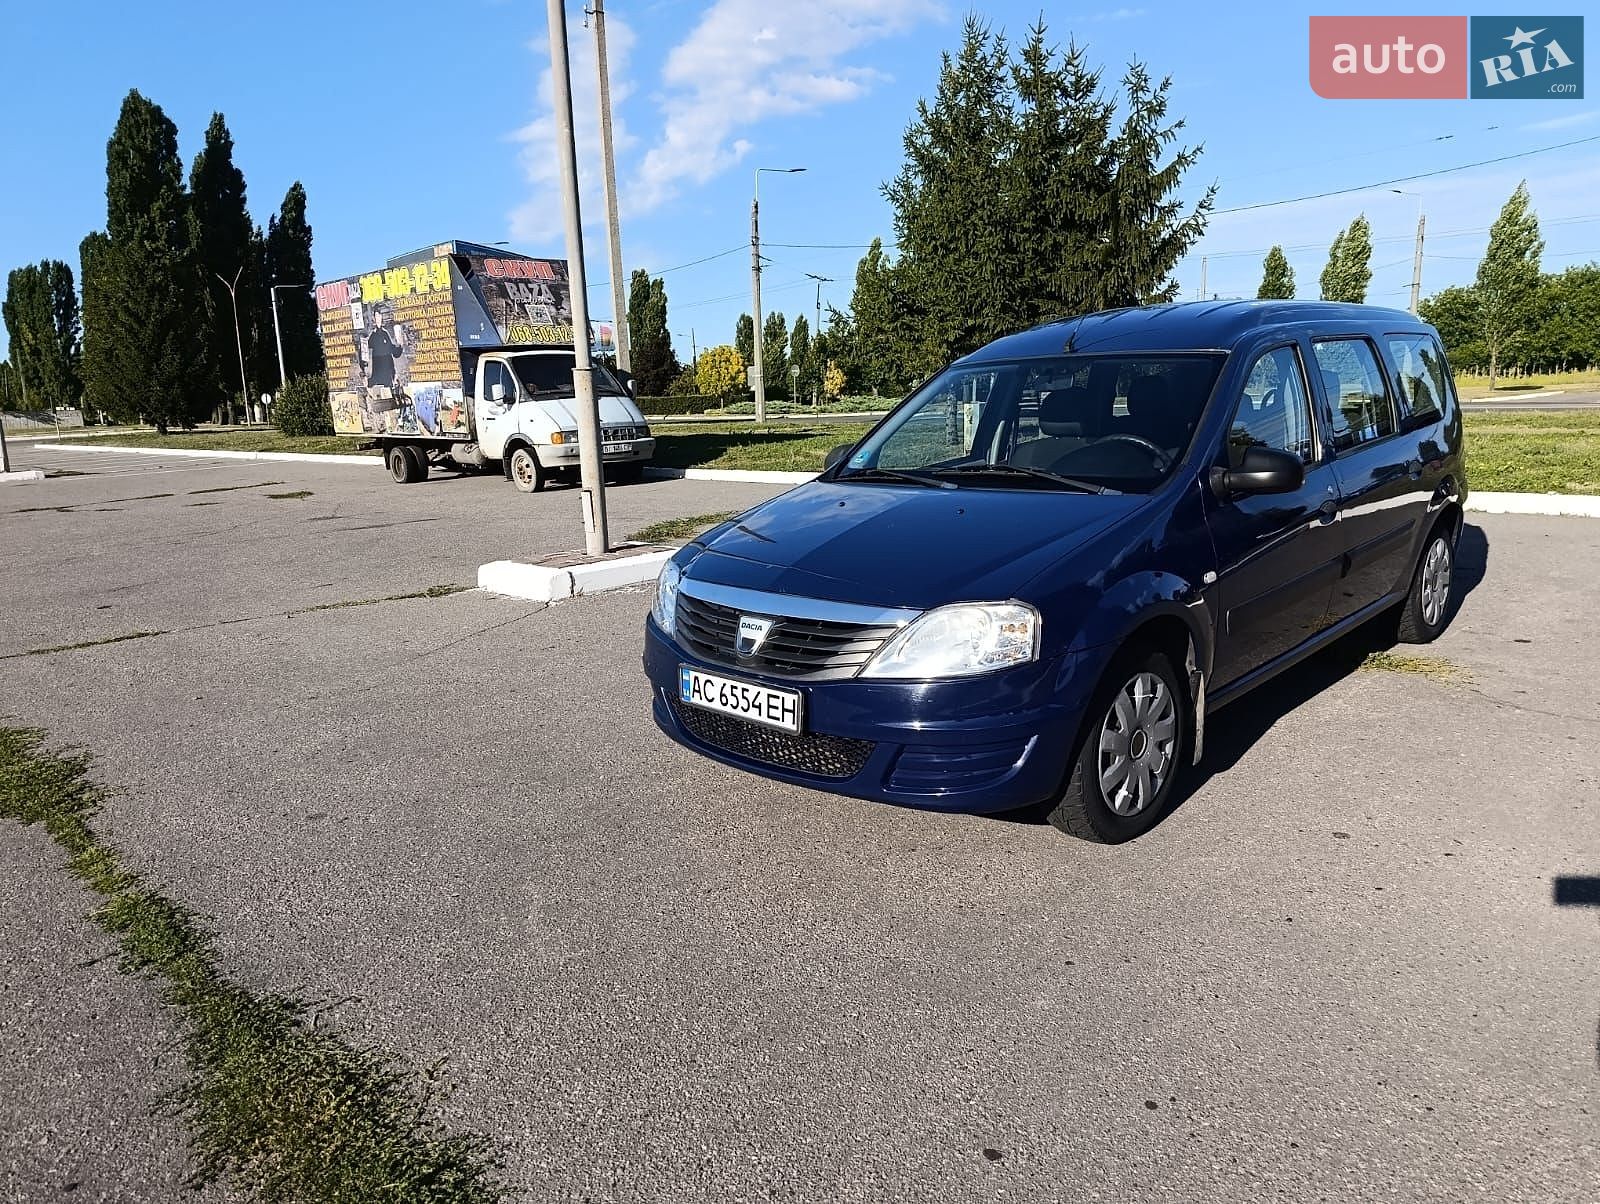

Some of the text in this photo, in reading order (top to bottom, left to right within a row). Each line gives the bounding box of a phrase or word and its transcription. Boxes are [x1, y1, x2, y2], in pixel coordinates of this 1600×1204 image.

[484, 258, 556, 280] СКУП
[504, 281, 557, 303] BAZA
[509, 325, 575, 342] 068-503-12-
[740, 622, 763, 632] DACIA
[691, 675, 796, 725] AC 6554 EH
